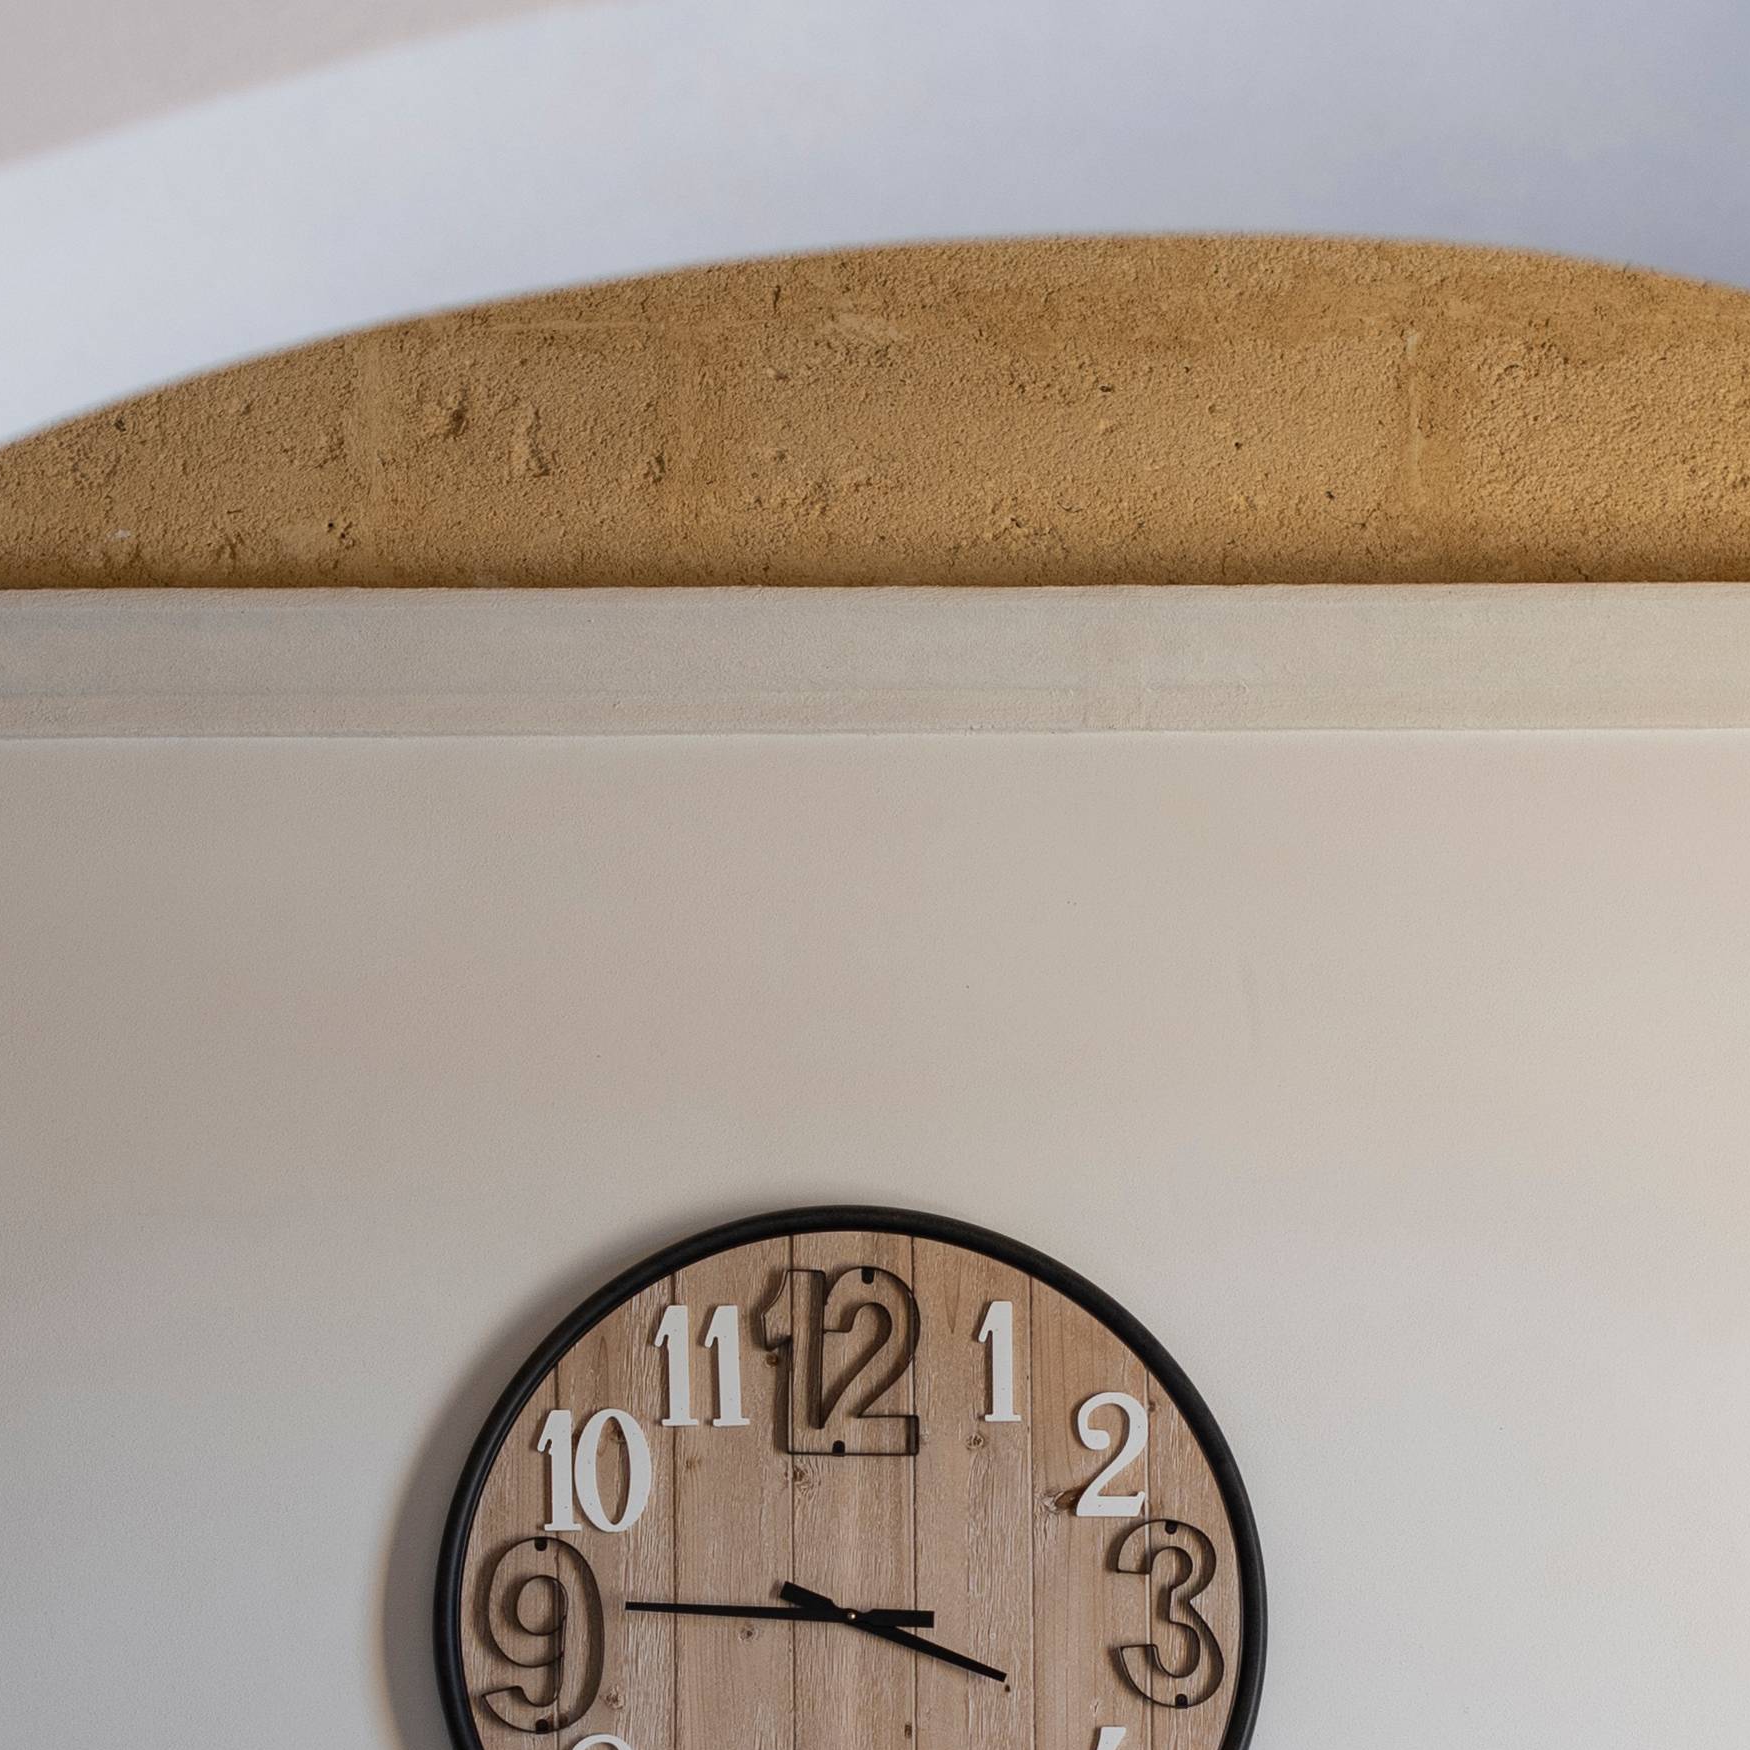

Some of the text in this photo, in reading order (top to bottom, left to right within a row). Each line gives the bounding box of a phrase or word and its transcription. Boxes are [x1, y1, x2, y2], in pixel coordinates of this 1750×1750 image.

[655, 1305, 750, 1426] 11
[761, 1266, 921, 1455] 12
[978, 1301, 1021, 1421] 1
[537, 1408, 651, 1532] 10
[1076, 1392, 1147, 1517] 2
[481, 1536, 604, 1733] 9
[1116, 1518, 1224, 1707] 3
